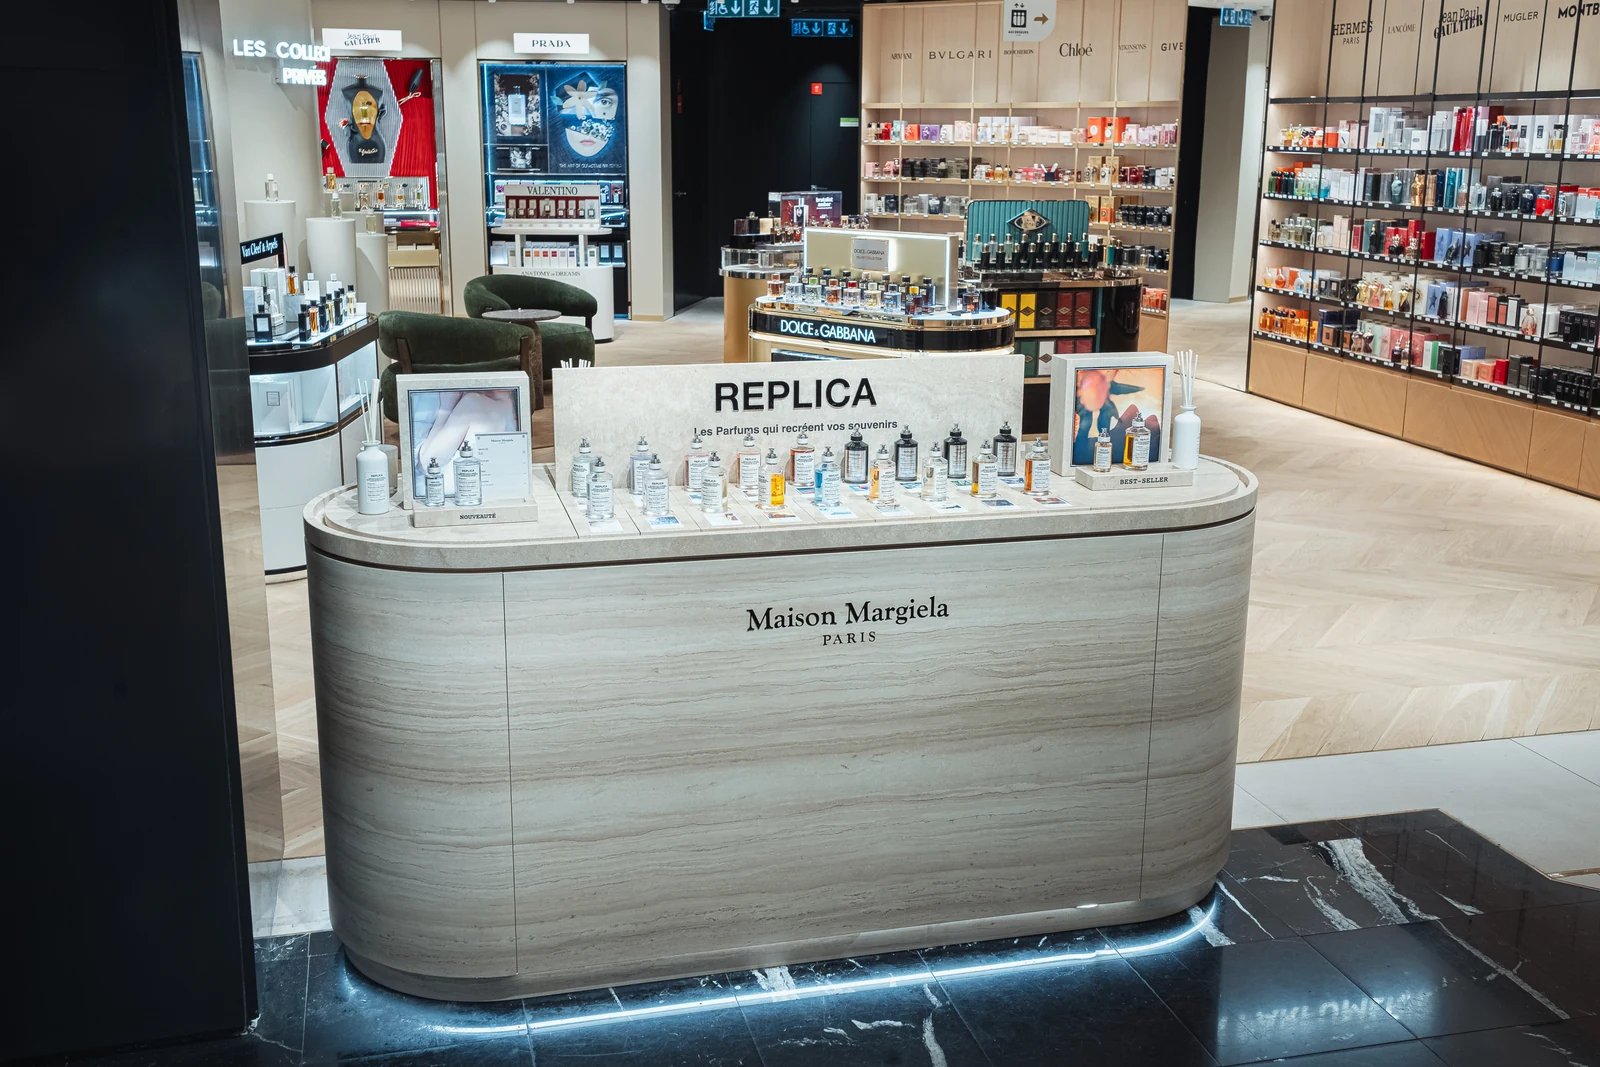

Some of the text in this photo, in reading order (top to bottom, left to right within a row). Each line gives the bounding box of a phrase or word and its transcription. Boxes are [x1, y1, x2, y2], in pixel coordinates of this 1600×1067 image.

[1460, 6, 1480, 20] Paul
[1503, 11, 1538, 22] MUGLER
[1332, 20, 1373, 36] HERMÈS
[1388, 23, 1416, 34] LANCÔME
[1434, 14, 1483, 38] GAULTIER
[232, 39, 266, 57] LES
[344, 38, 380, 46] GAULTIER
[1342, 37, 1360, 45] PARIS
[929, 50, 992, 59] BVLGARI
[1059, 43, 1092, 57] Chloé
[527, 186, 578, 195] VALENTINO
[242, 245, 250, 257] Van
[251, 241, 262, 255] Cleef
[266, 237, 278, 254] Arpels
[715, 378, 877, 412] REPLICA
[694, 427, 713, 436] Les
[716, 426, 760, 436] Parfums
[762, 425, 778, 436] qui
[782, 422, 824, 433] recréent
[848, 420, 898, 430] souvenirs
[746, 596, 949, 632] Maison Margiela
[822, 631, 876, 646] PARIS
